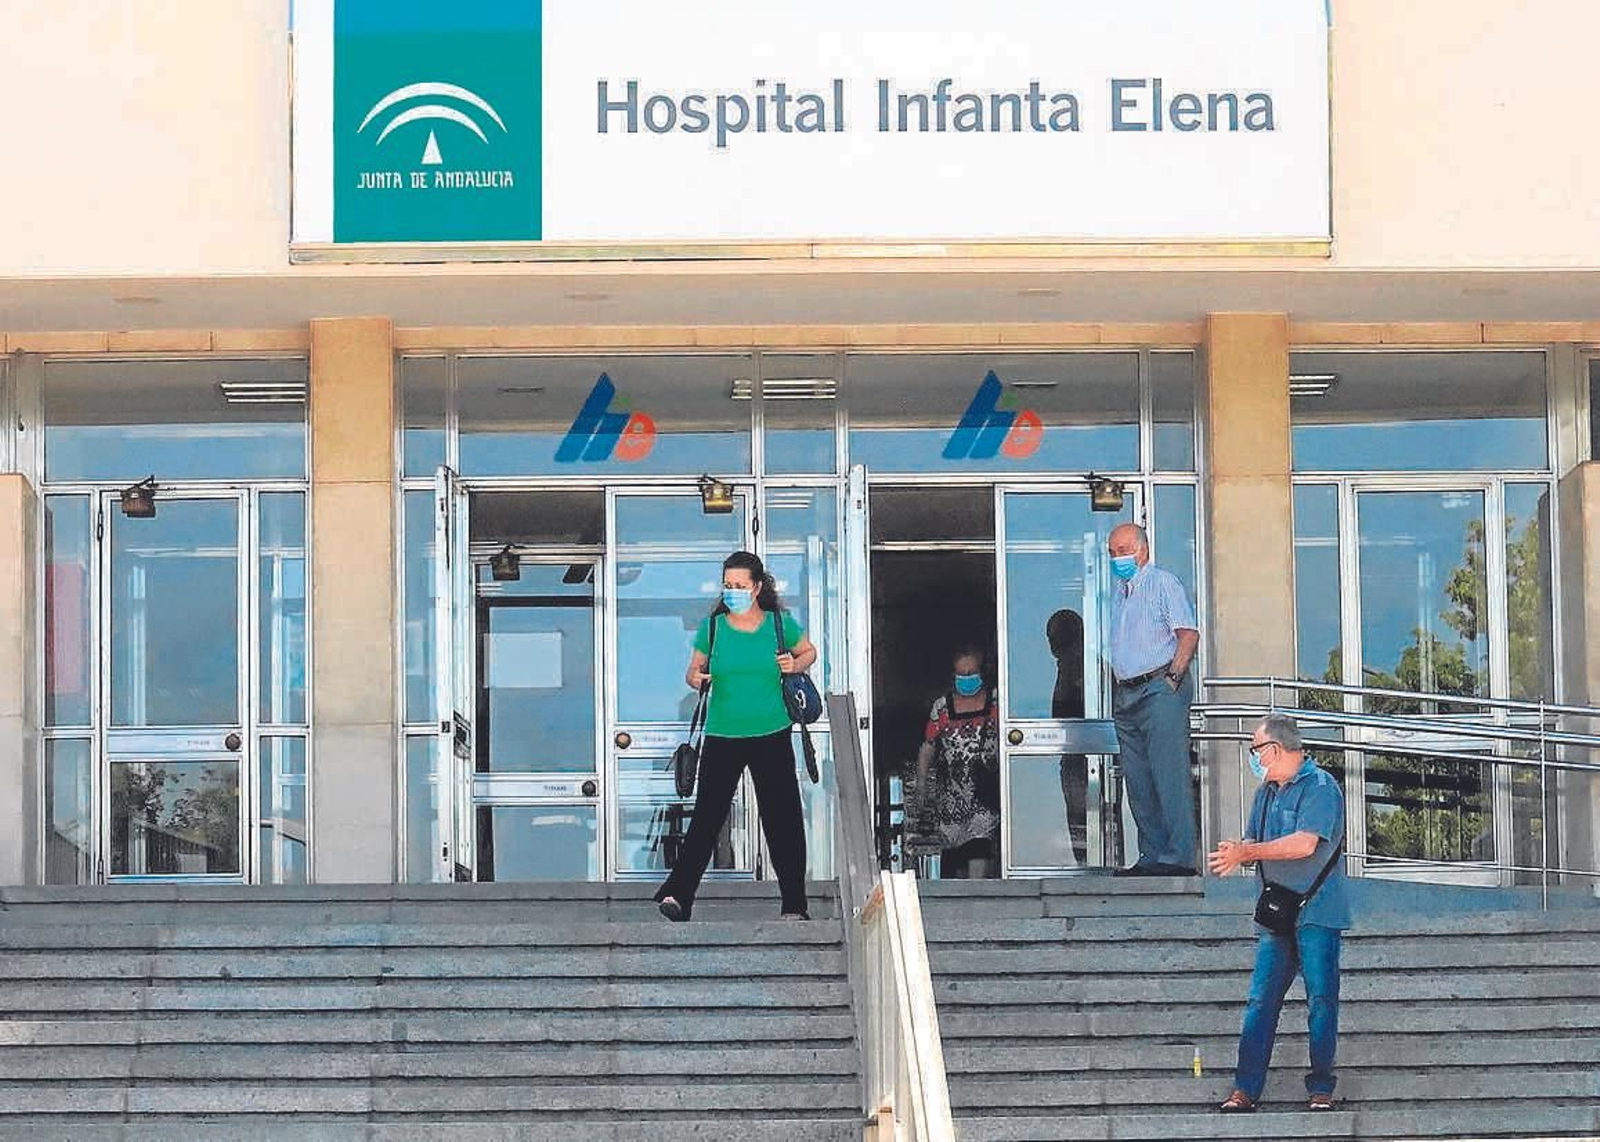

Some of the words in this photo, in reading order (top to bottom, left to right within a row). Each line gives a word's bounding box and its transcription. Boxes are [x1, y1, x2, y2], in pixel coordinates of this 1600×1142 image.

[597, 78, 844, 148] Hospital
[879, 78, 1079, 133] Infanta
[1111, 78, 1275, 132] Elena
[357, 172, 403, 189] JUNTA
[410, 172, 428, 189] DE
